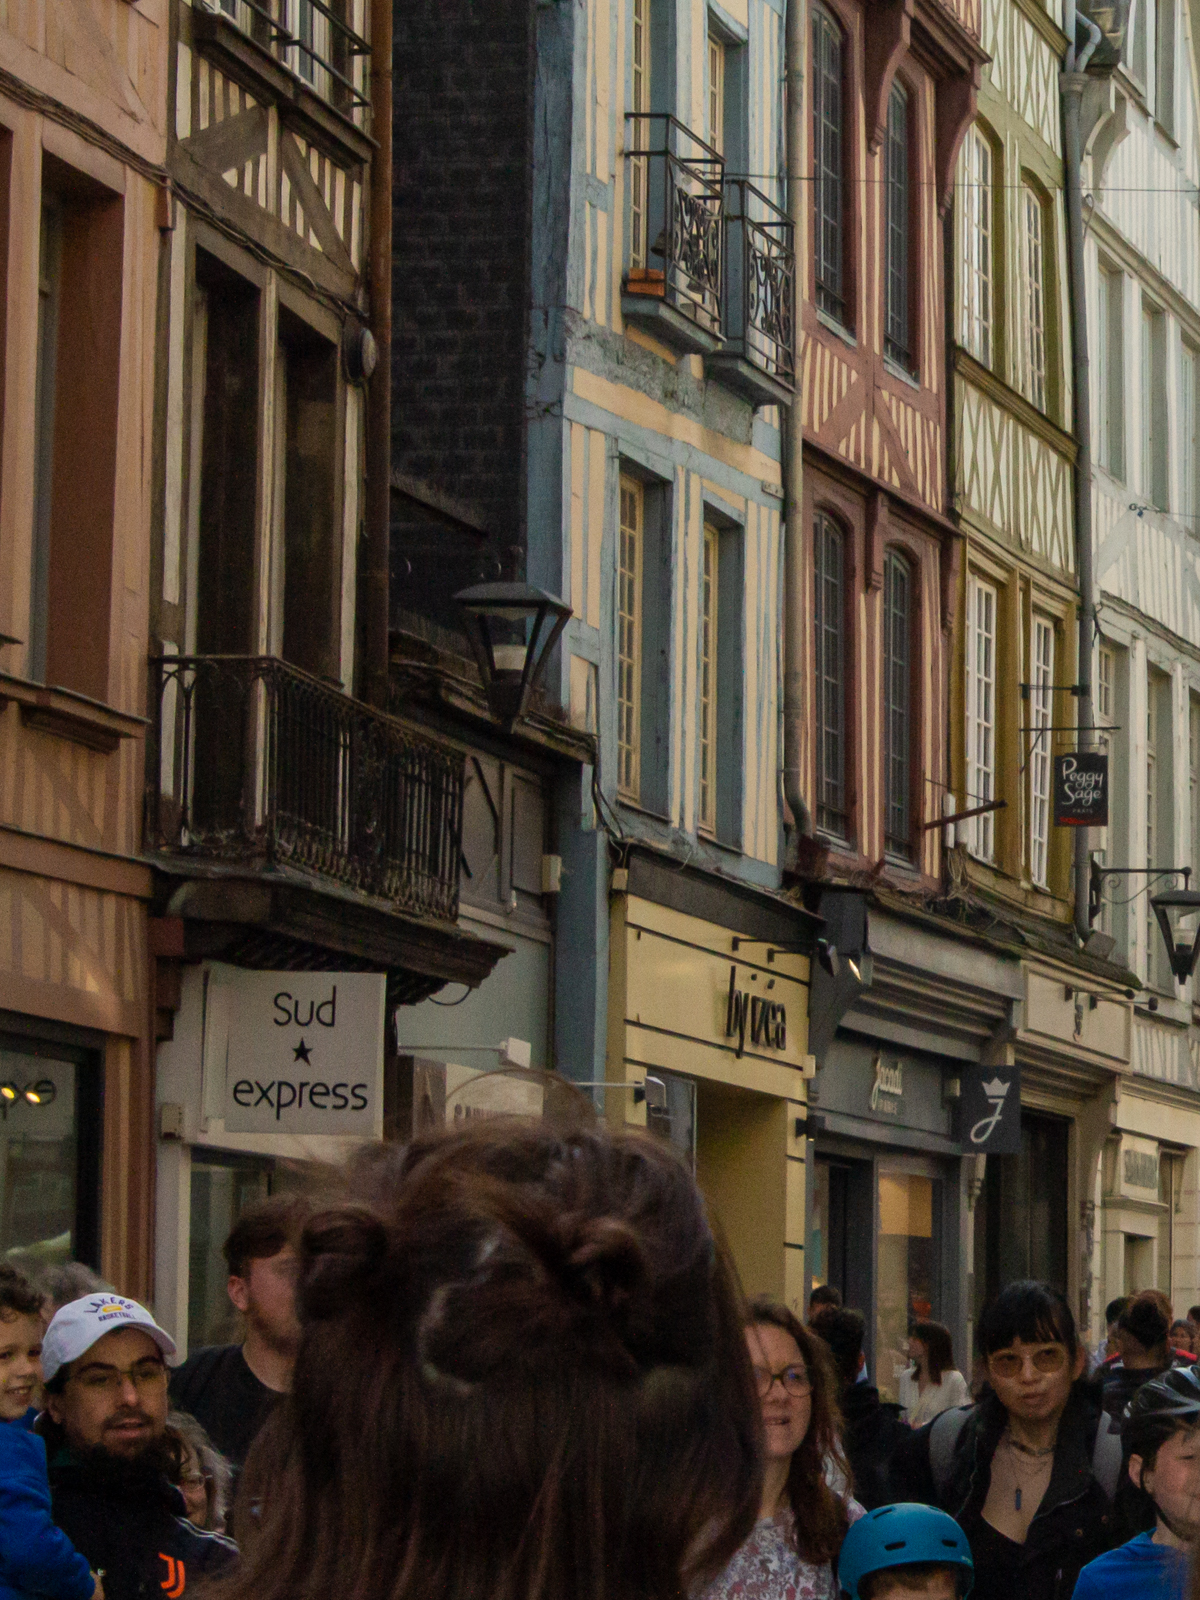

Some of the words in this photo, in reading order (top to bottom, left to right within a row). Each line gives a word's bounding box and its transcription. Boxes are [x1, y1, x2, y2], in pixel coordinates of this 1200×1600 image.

[1061, 757, 1104, 788] Peggy
[1061, 782, 1102, 806] Sage
[273, 984, 337, 1027] Sud
[726, 965, 750, 1060] by
[232, 1079, 368, 1121] express
[83, 1296, 134, 1314] LAKERS
